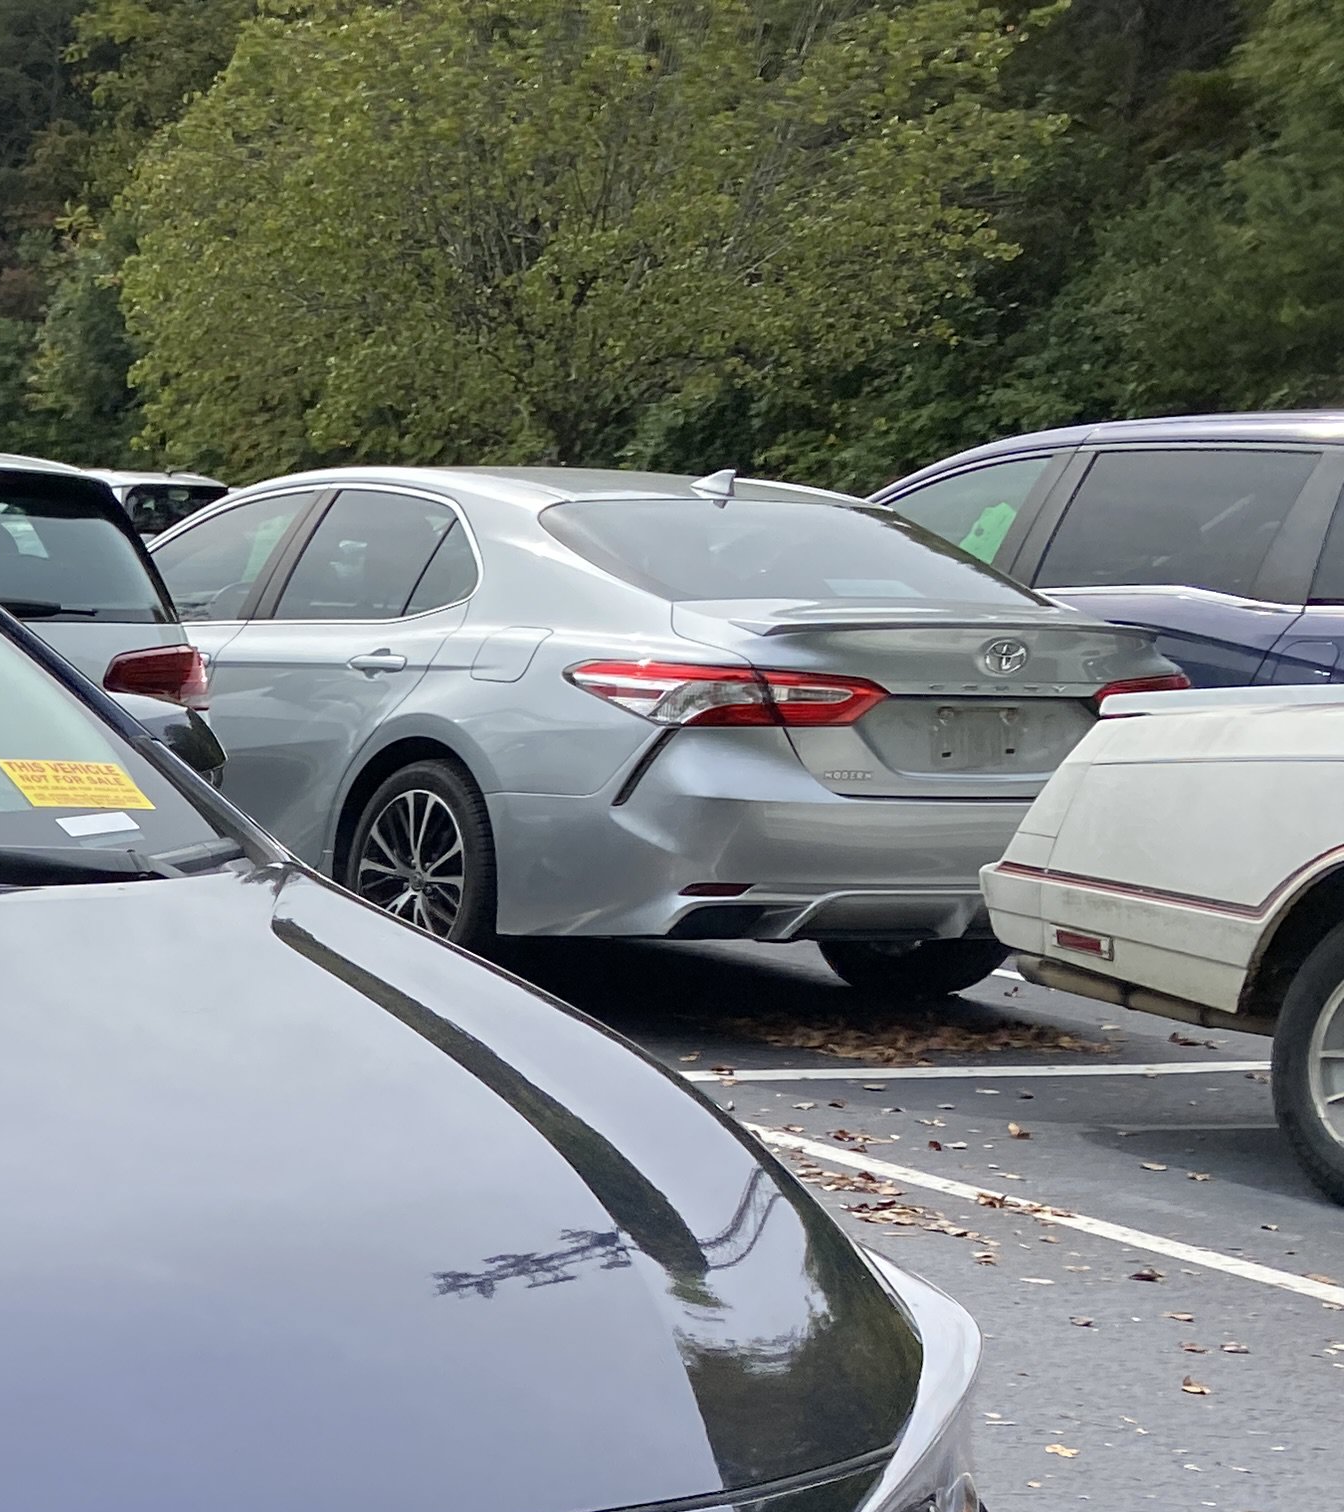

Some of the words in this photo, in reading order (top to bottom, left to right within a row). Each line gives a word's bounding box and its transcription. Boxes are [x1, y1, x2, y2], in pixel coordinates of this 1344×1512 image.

[3, 761, 46, 773] THIS
[46, 762, 121, 777] VEHICLE
[18, 774, 50, 783] NOT
[52, 775, 84, 784] FOR
[86, 776, 126, 786] SALE
